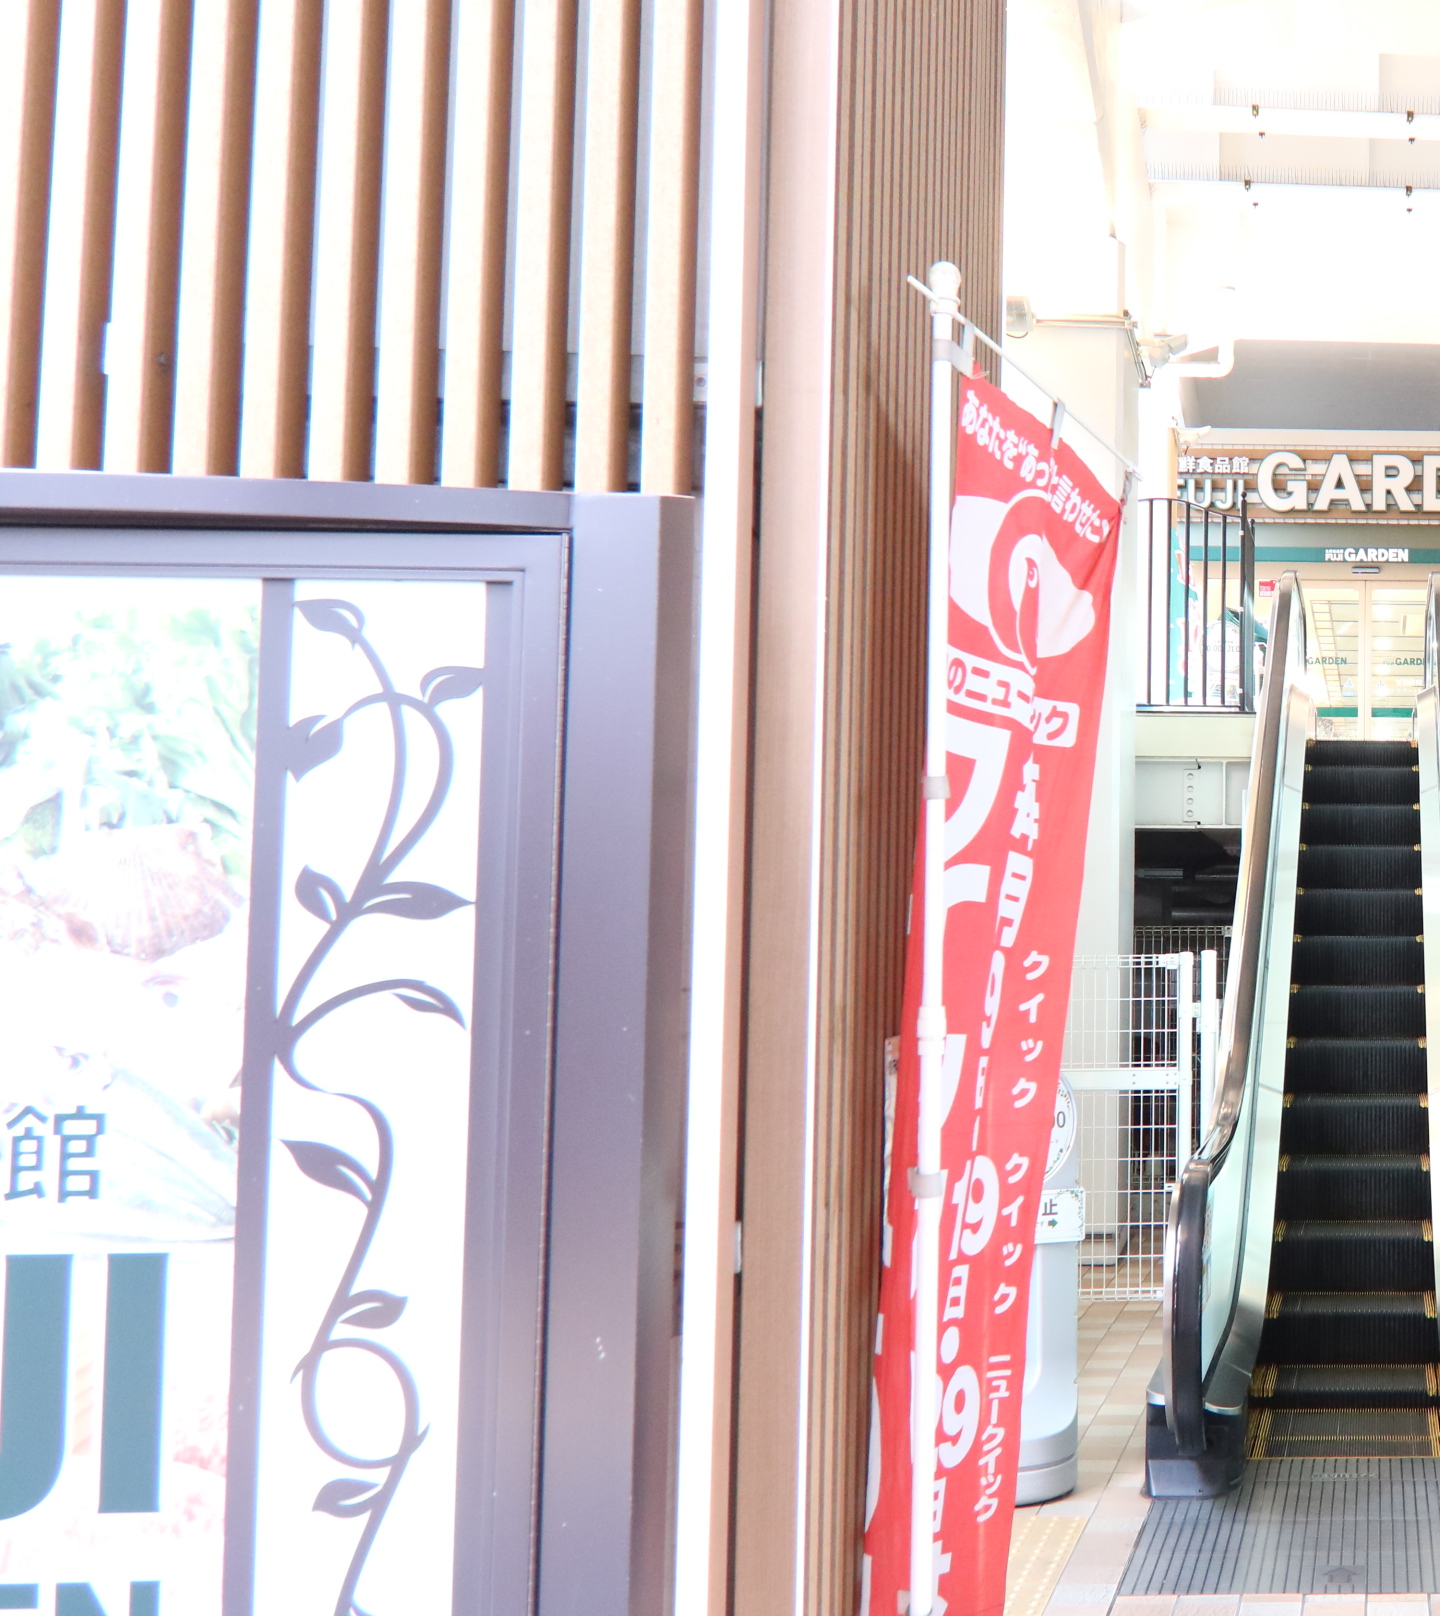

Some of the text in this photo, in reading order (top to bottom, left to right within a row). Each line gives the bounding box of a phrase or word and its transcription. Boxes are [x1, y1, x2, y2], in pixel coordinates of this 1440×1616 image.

[1344, 547, 1409, 562] GARDEN
[1307, 656, 1348, 665] GARDEN
[973, 950, 1050, 1523] クイック クイック ニュークイック
